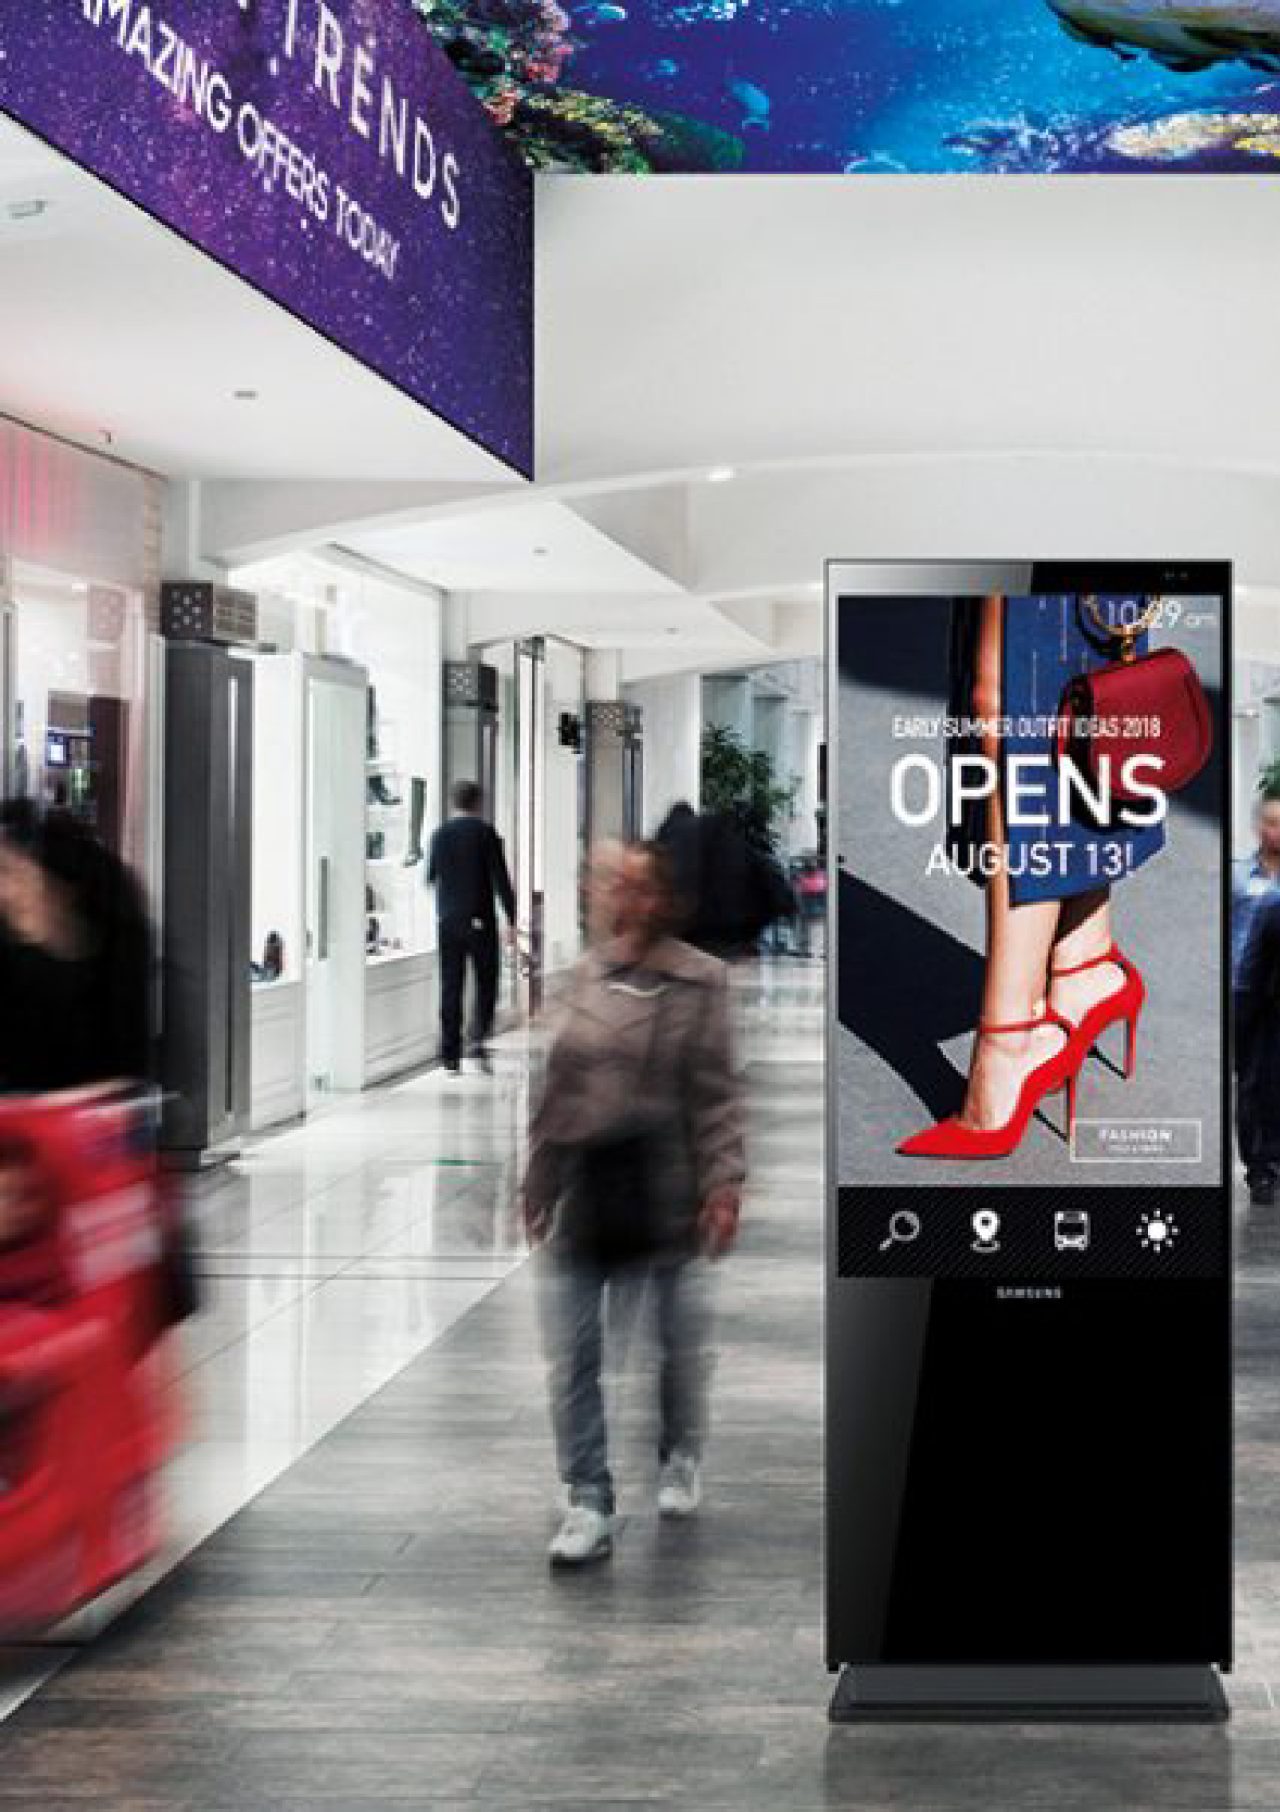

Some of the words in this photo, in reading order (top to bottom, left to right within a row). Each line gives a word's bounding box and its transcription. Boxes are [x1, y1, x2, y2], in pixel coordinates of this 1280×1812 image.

[83, 0, 232, 133] MAZING
[238, 102, 329, 220] OFFERS
[336, 185, 400, 279] TODAY
[894, 716, 940, 738] EARLY
[942, 716, 1013, 738] SUMMER
[1018, 716, 1069, 738] OUTFIT
[1075, 716, 1118, 738] IDEAS
[1122, 716, 1160, 738] 2018
[891, 754, 1168, 827] OPENS
[925, 843, 1074, 877] AUGUST
[1087, 843, 1134, 877] 13!
